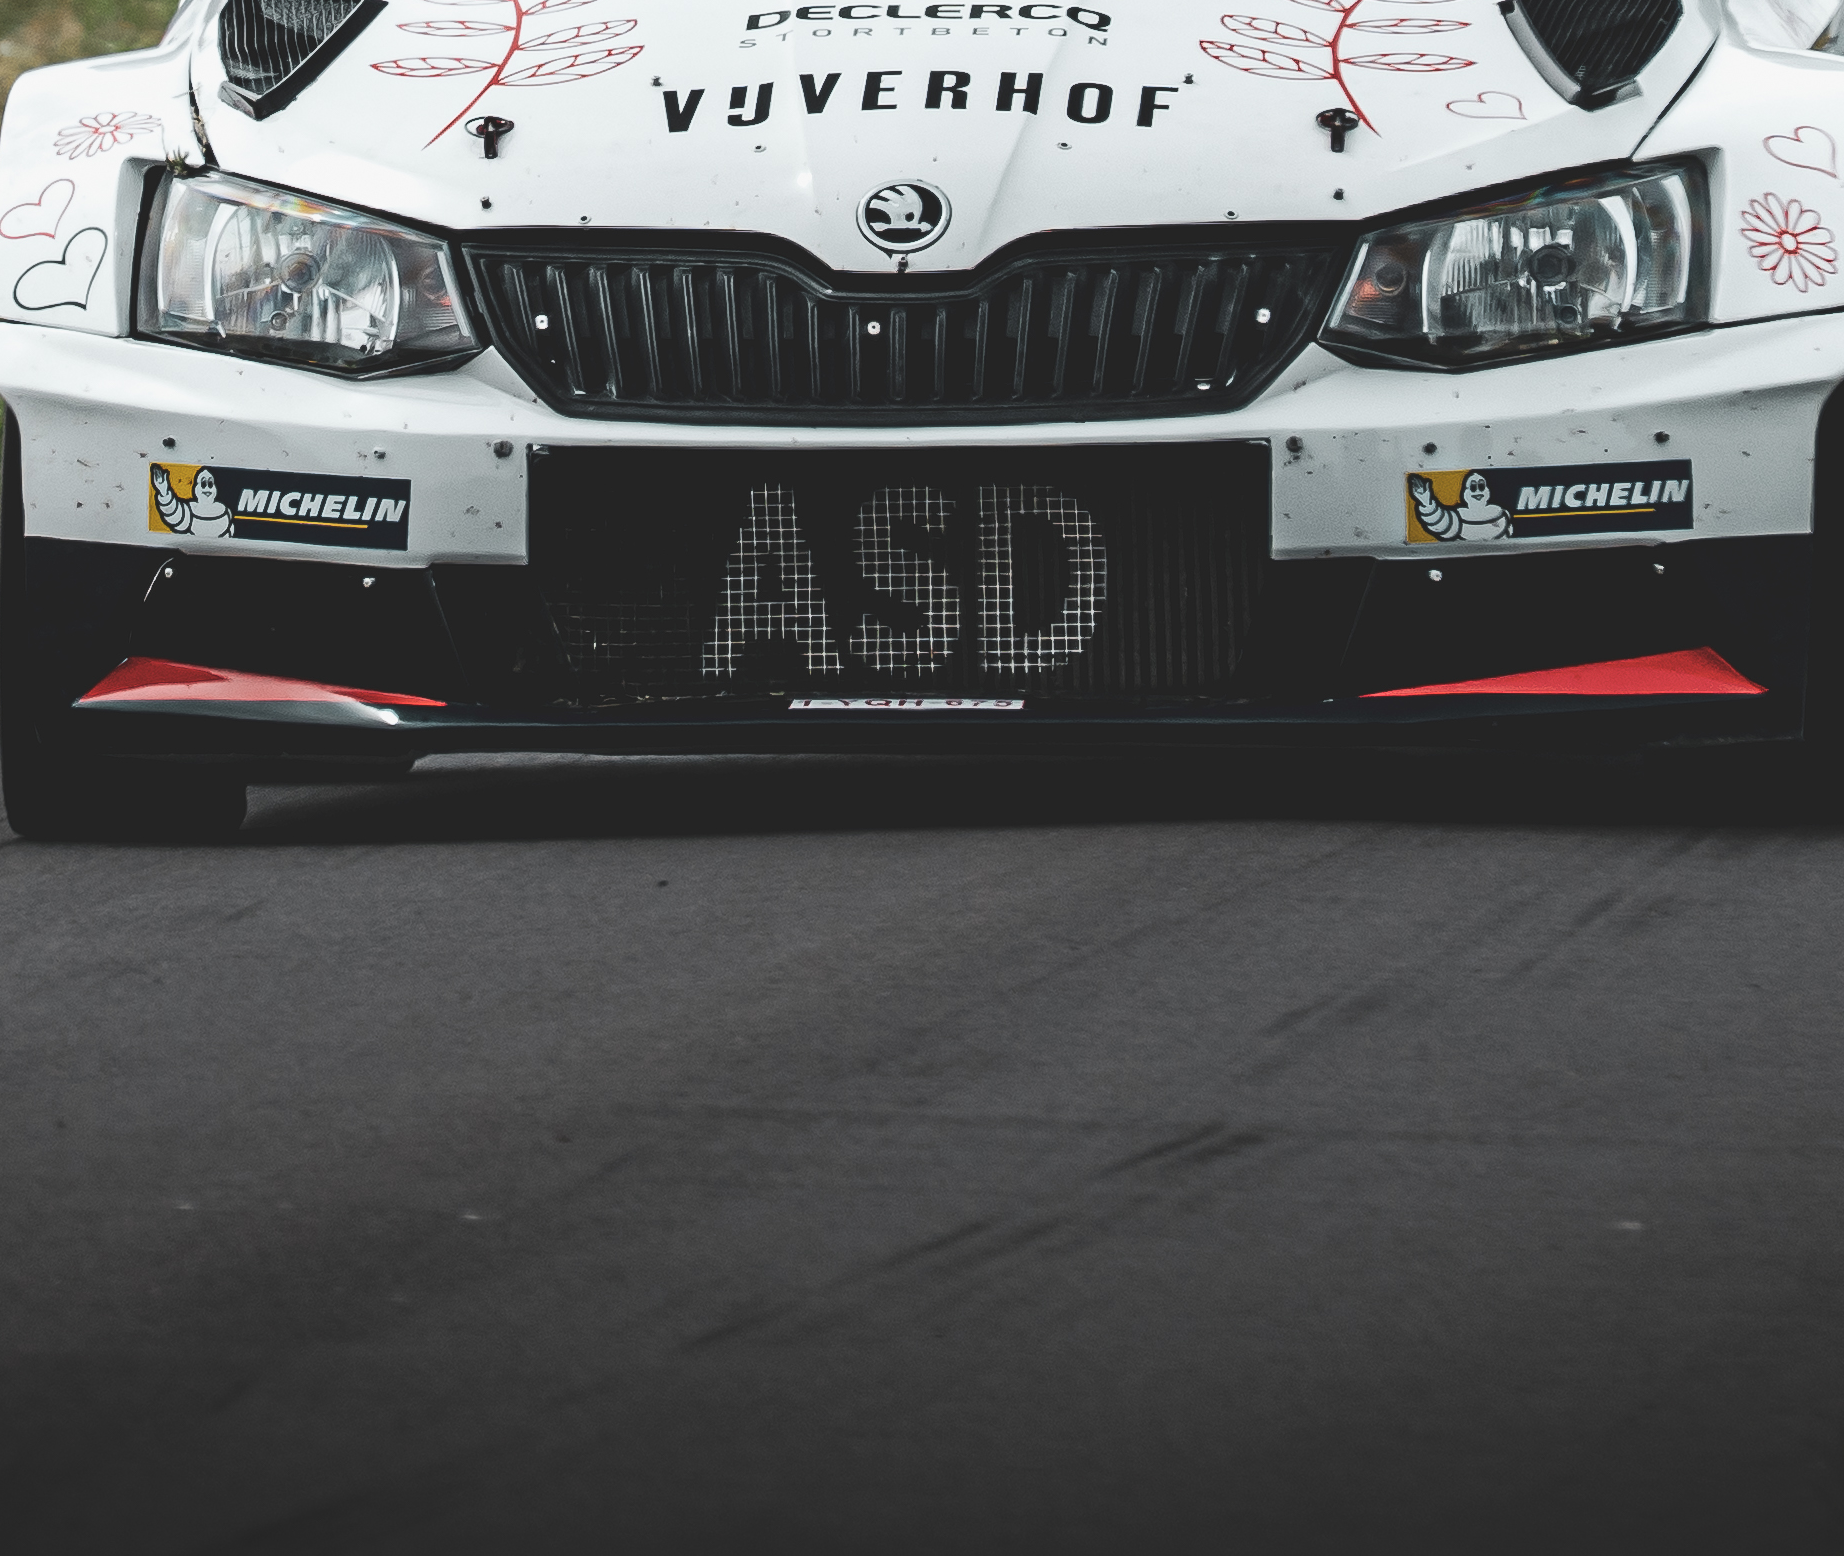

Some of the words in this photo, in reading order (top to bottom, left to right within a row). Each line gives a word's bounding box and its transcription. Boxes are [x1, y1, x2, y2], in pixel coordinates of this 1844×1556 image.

[745, 4, 1112, 32] DECLERCQ
[738, 26, 1109, 49] STORTBETON
[237, 488, 406, 523] MICHELIN
[1516, 479, 1690, 510] MICHELIN
[702, 483, 1108, 678] ASD
